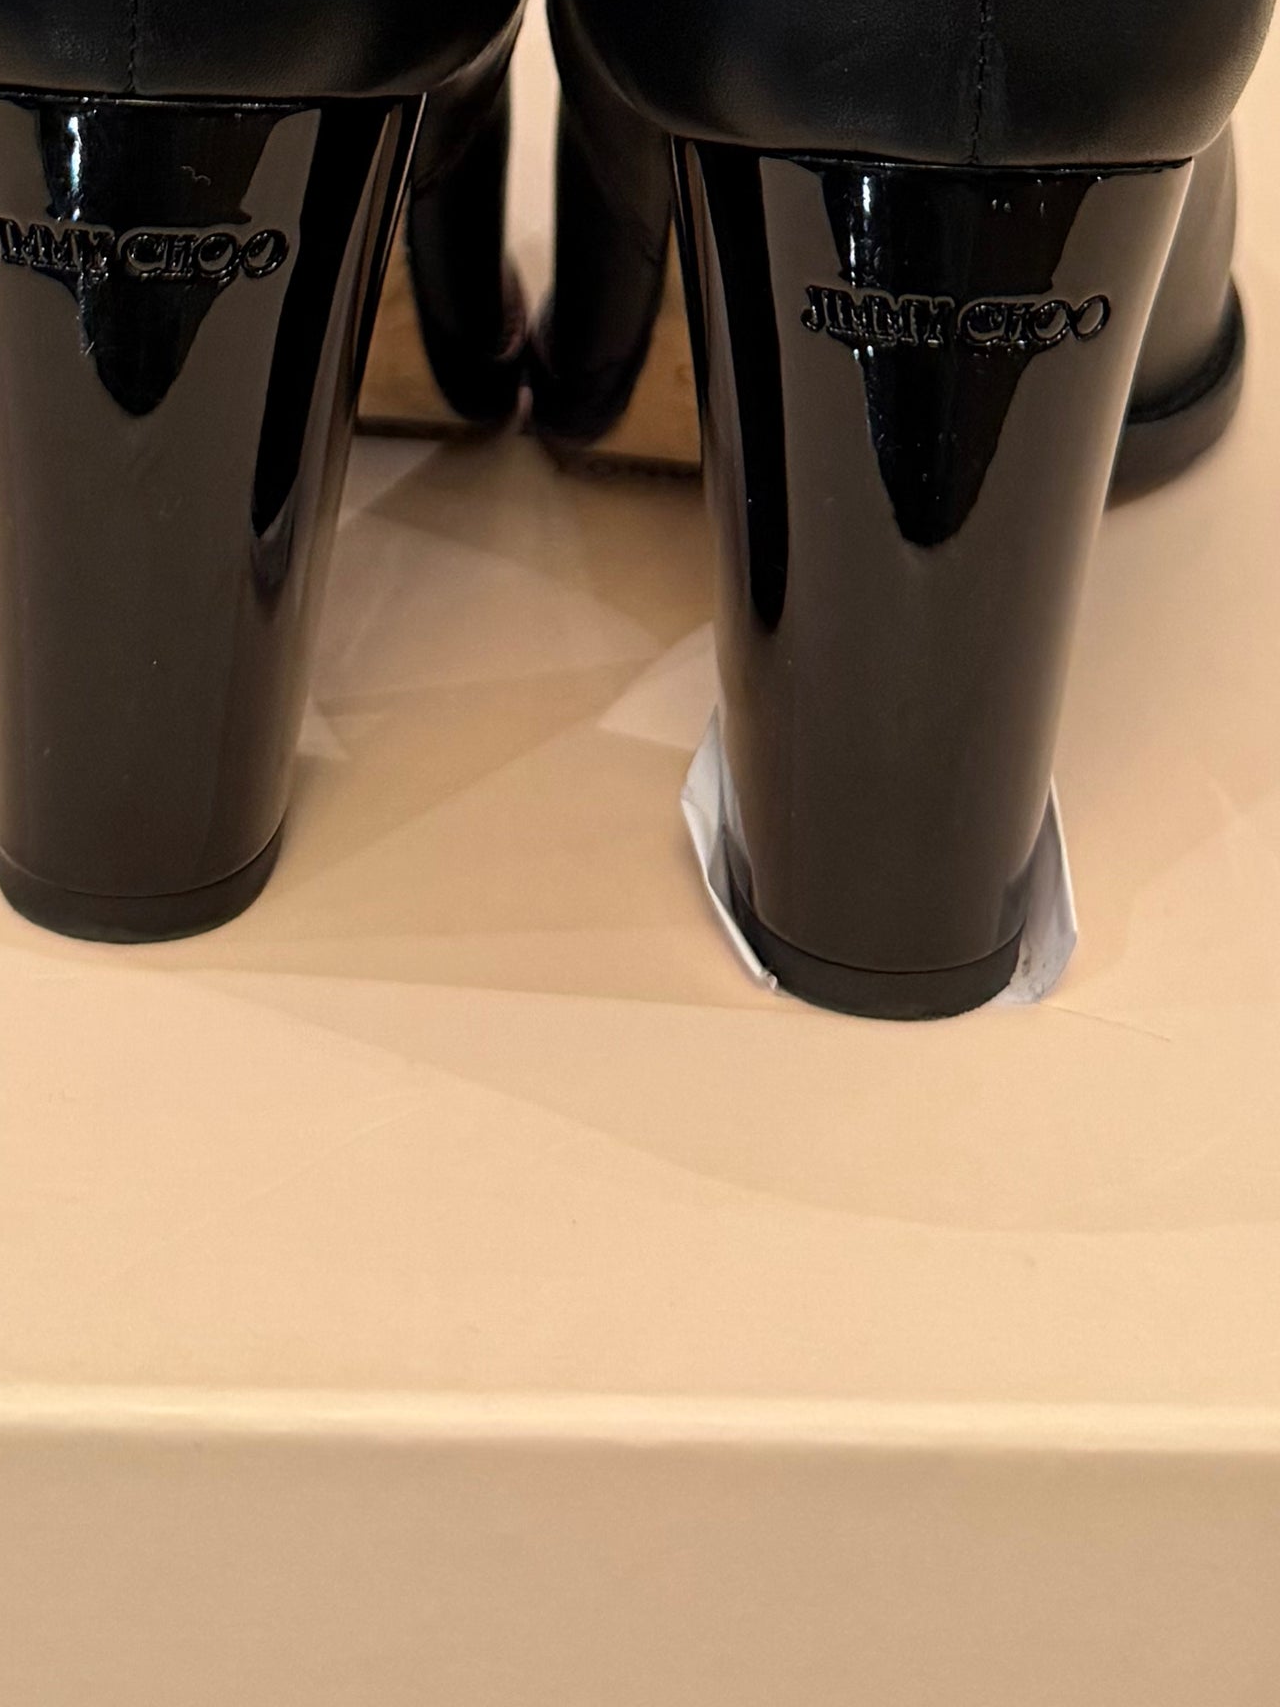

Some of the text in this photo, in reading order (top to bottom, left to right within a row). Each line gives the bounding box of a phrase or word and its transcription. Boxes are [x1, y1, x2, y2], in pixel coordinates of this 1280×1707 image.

[122, 230, 287, 281] CHOO
[801, 285, 1111, 346] JIMMY CHOO
